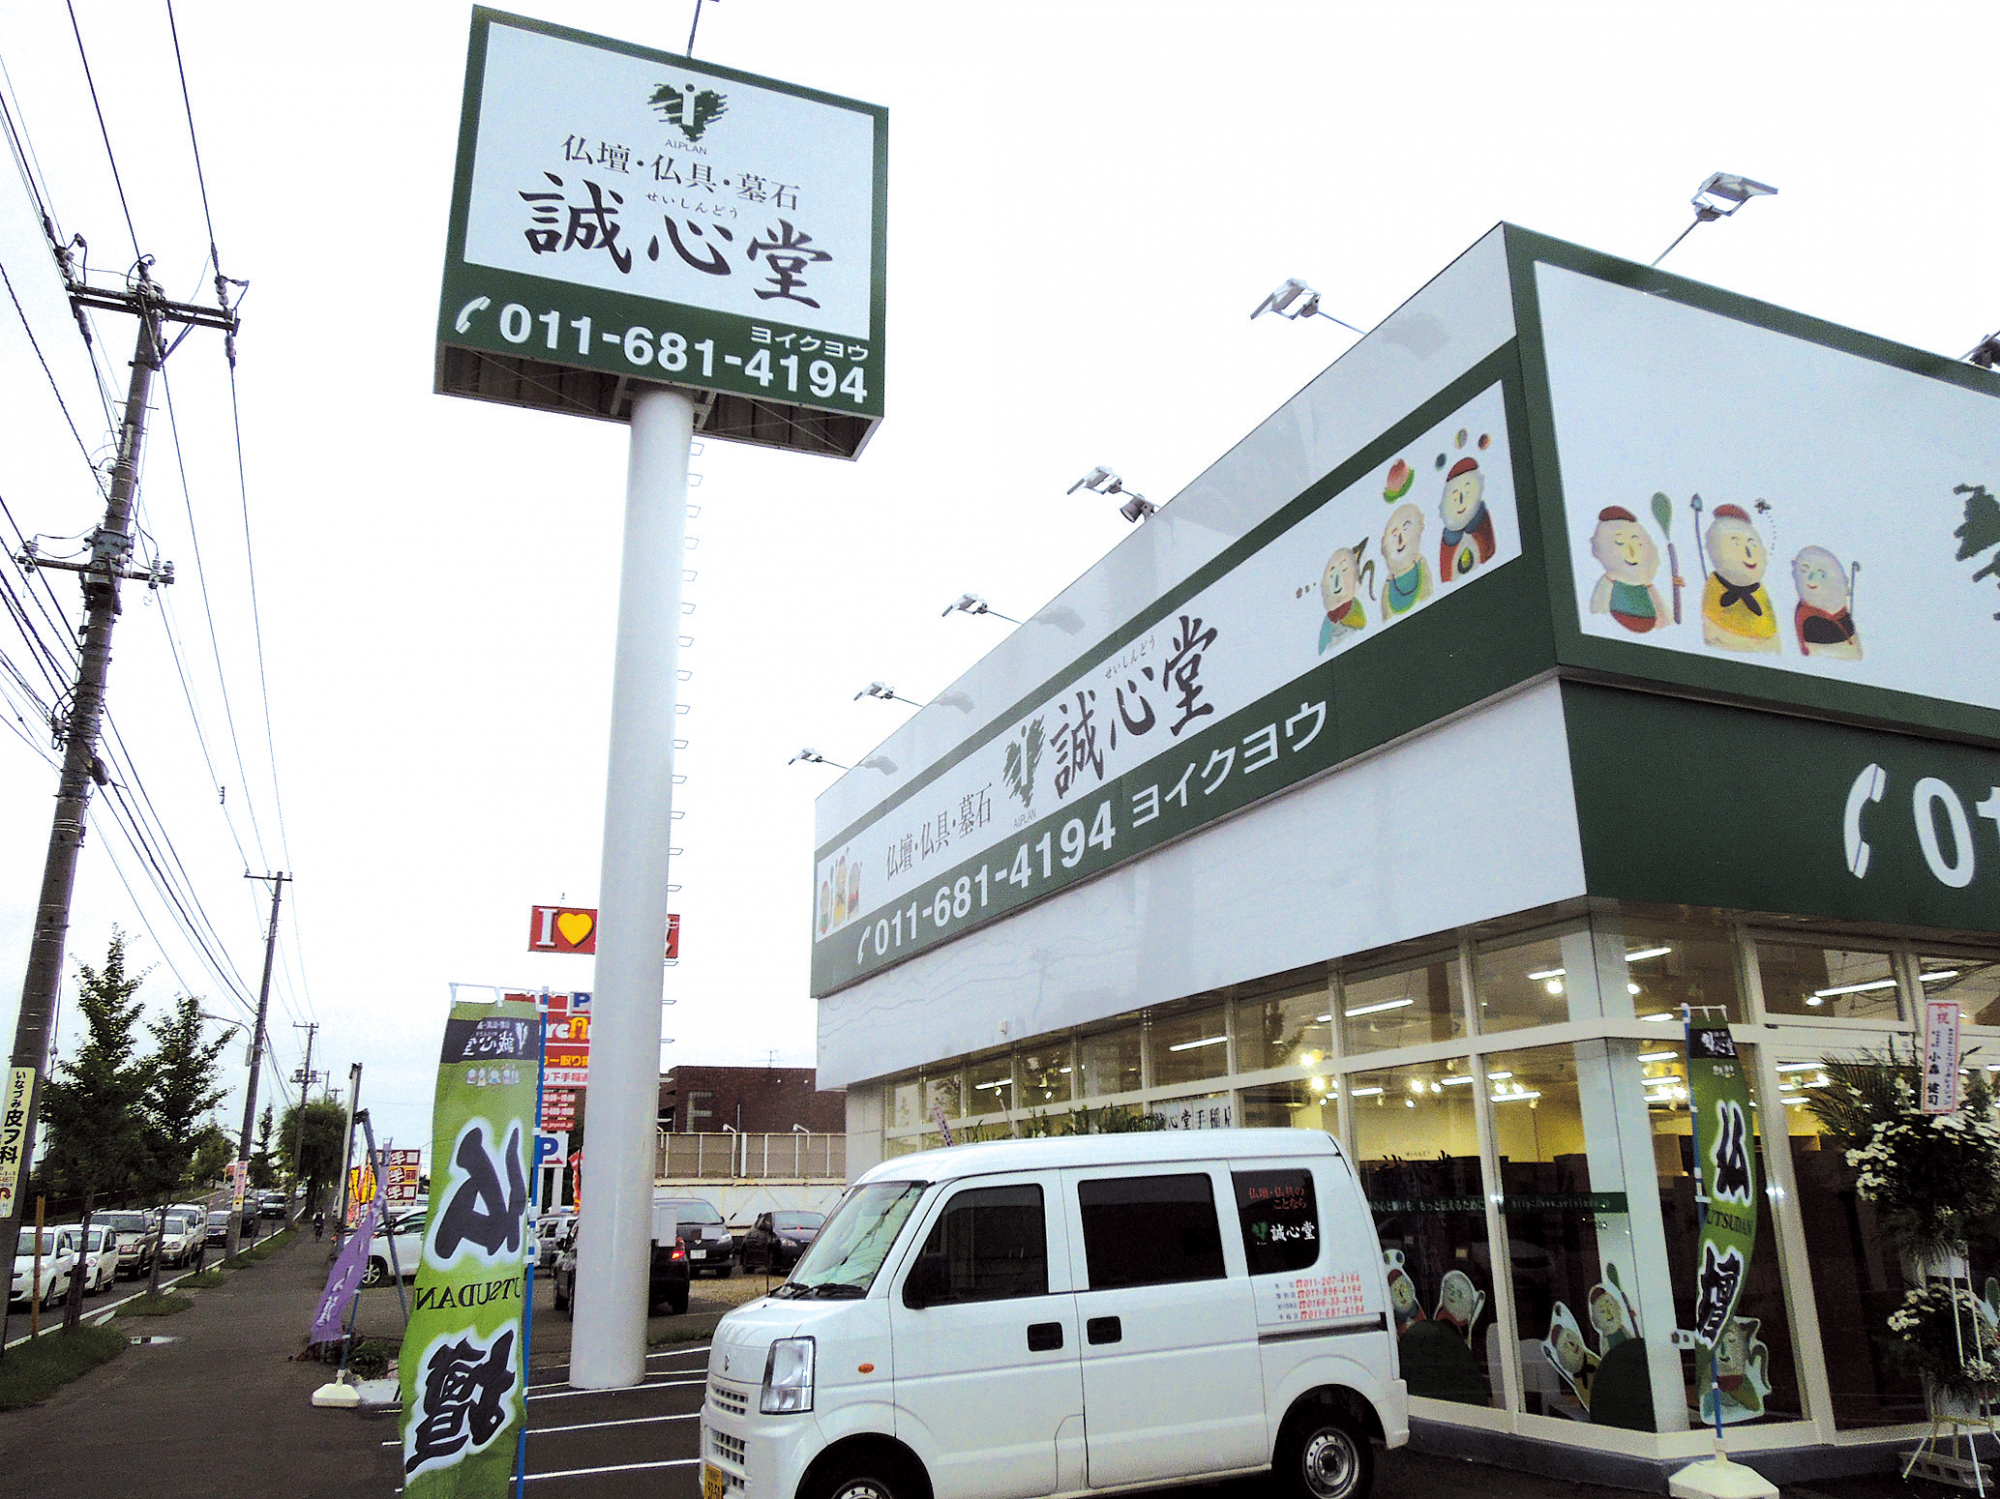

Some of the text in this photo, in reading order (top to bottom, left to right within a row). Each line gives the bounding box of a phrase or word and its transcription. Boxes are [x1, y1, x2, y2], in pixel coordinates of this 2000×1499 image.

[560, 133, 801, 211] 仏壇・仏具・墓石
[645, 190, 739, 220] せいしんどう
[517, 171, 833, 309] 誠心堂
[499, 303, 868, 404] 011-681-4194
[751, 326, 869, 361] ヨイクヨウ
[1049, 614, 1218, 800] 誠心堂
[1131, 700, 1328, 828] ヨイクヨウ
[874, 803, 1116, 956] 011-681-4194
[885, 781, 993, 882] 仏壇・仏具・墓石
[1269, 1221, 1316, 1242] 誠心堂
